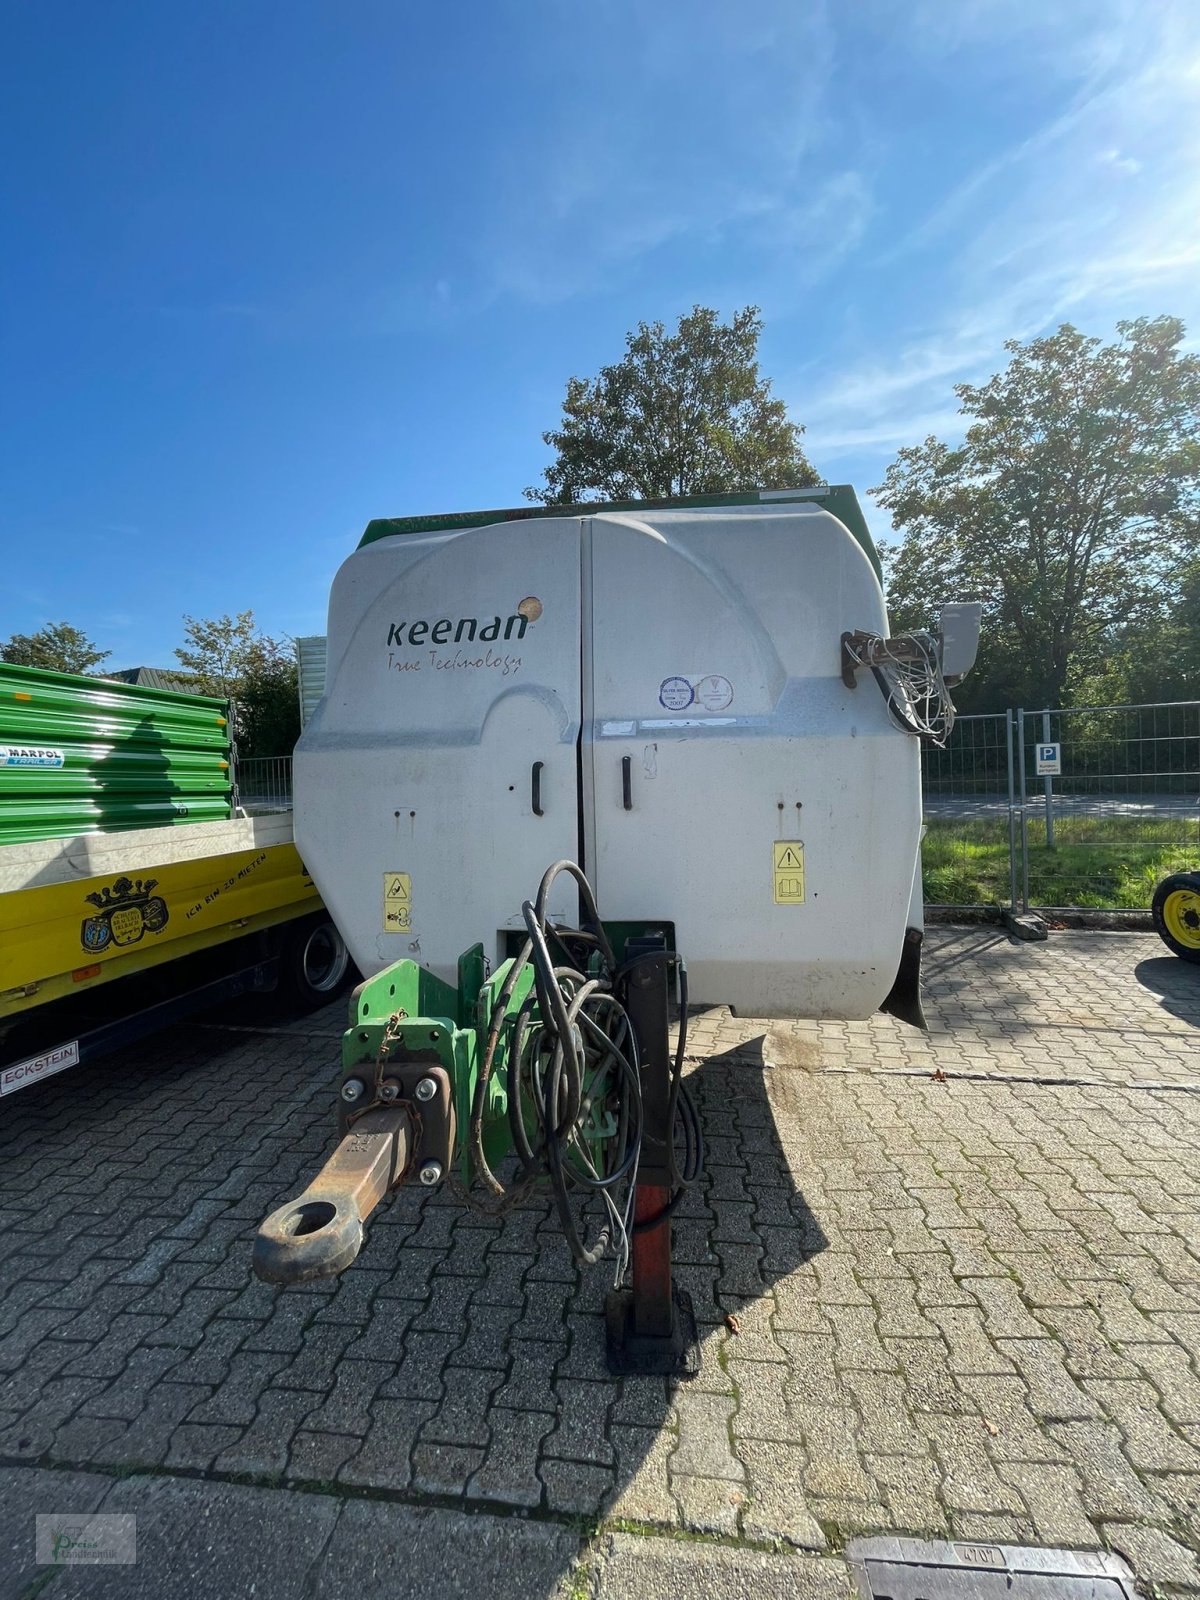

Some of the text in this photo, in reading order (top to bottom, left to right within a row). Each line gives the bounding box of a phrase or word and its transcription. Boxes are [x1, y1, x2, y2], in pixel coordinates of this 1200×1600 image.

[387, 649, 522, 675] True Technology
[8, 749, 61, 758] MARPOL
[185, 903, 203, 920] ICH
[204, 887, 221, 905] BIN
[237, 853, 267, 880] MIETEN
[4, 1047, 73, 1084] ECKSTEIN
